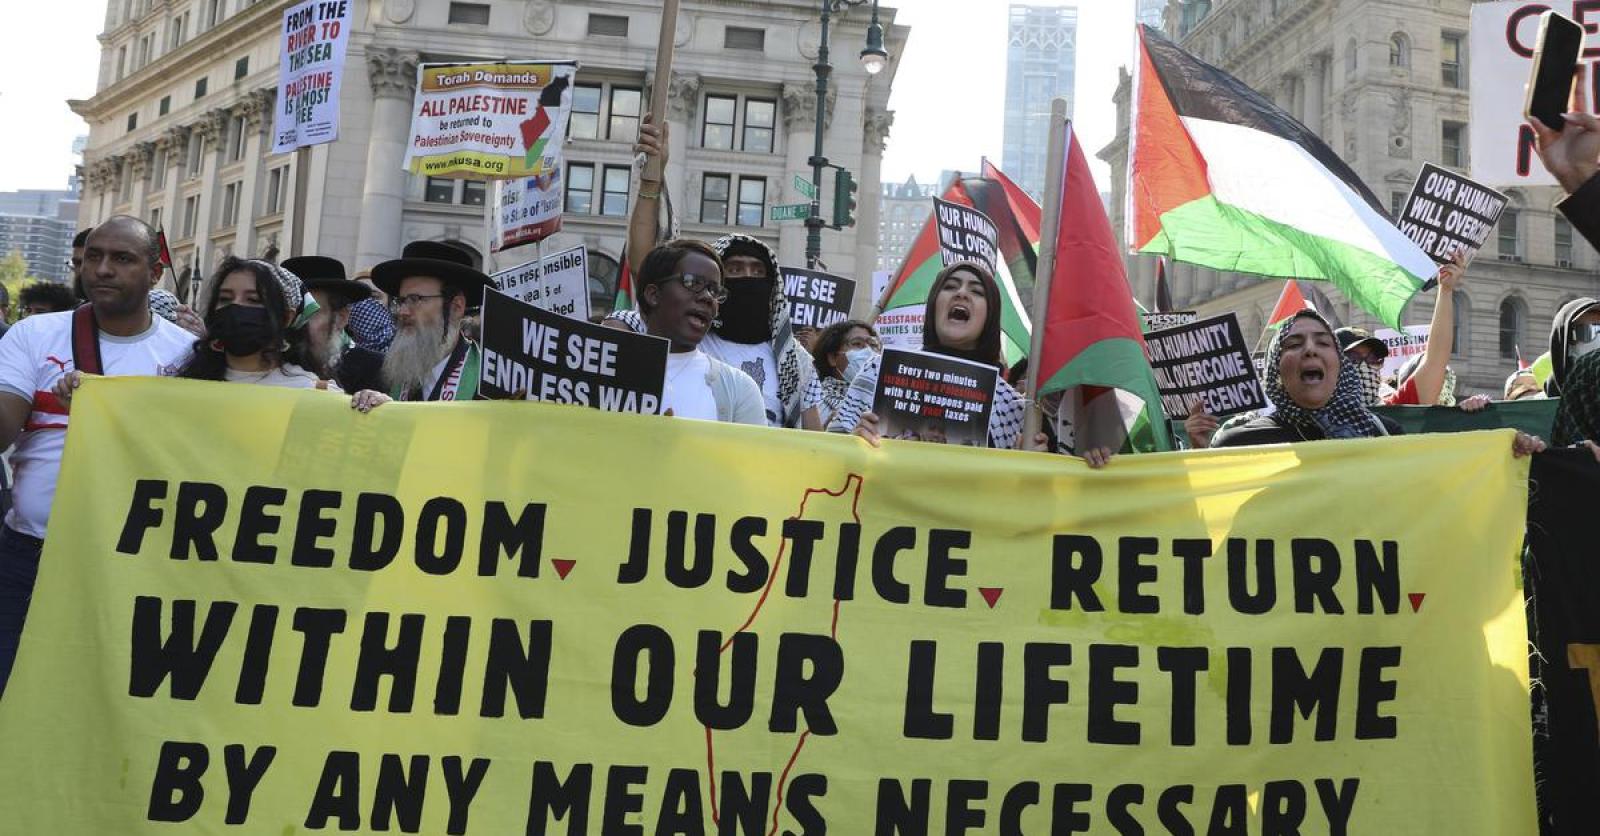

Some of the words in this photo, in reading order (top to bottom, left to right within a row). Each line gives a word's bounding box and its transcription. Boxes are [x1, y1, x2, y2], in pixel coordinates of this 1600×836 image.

[286, 5, 313, 33] FROM
[319, 1, 347, 20] THE
[287, 25, 316, 53] RIVER
[322, 21, 341, 40] TO
[289, 49, 305, 72] THE
[307, 42, 332, 64] SEA
[437, 71, 470, 86] Torah
[475, 70, 537, 85] Demands
[285, 96, 293, 115] IS
[419, 99, 446, 117] ALL
[449, 95, 528, 115] PALESTINE
[440, 120, 448, 130] be
[449, 115, 479, 129] returned
[482, 117, 492, 128] to
[414, 134, 459, 147] Palestinian
[460, 130, 516, 149] Sovereignty
[1424, 172, 1457, 202] OUR
[530, 201, 540, 216] of
[939, 204, 961, 228] OUR
[1409, 196, 1444, 227] WILL
[507, 275, 517, 288] is
[519, 253, 582, 285] respnsible
[784, 274, 808, 297] WE
[810, 278, 837, 303] SEE
[880, 325, 909, 335] UNITES
[1162, 322, 1232, 360] HUMANITY
[522, 318, 560, 364] WE
[565, 333, 618, 377] SEE
[483, 348, 590, 408] ENDLESS
[898, 363, 922, 378] Every
[924, 368, 941, 380] two
[943, 373, 977, 388] minutes
[1172, 352, 1248, 388] OVERCOME
[884, 386, 904, 398] with
[905, 389, 921, 401] U.S.
[924, 393, 963, 408] weapons
[964, 401, 983, 413] paid
[894, 399, 907, 411] for
[909, 402, 921, 414] by
[945, 408, 969, 422] taxes
[129, 596, 553, 719] WITHIN
[611, 624, 844, 735] OUR
[904, 640, 1402, 747] LIFETIME
[148, 741, 277, 825] BY
[304, 751, 492, 836] ANY
[526, 761, 828, 836] MEANS
[875, 778, 1361, 836] NECESSARY
